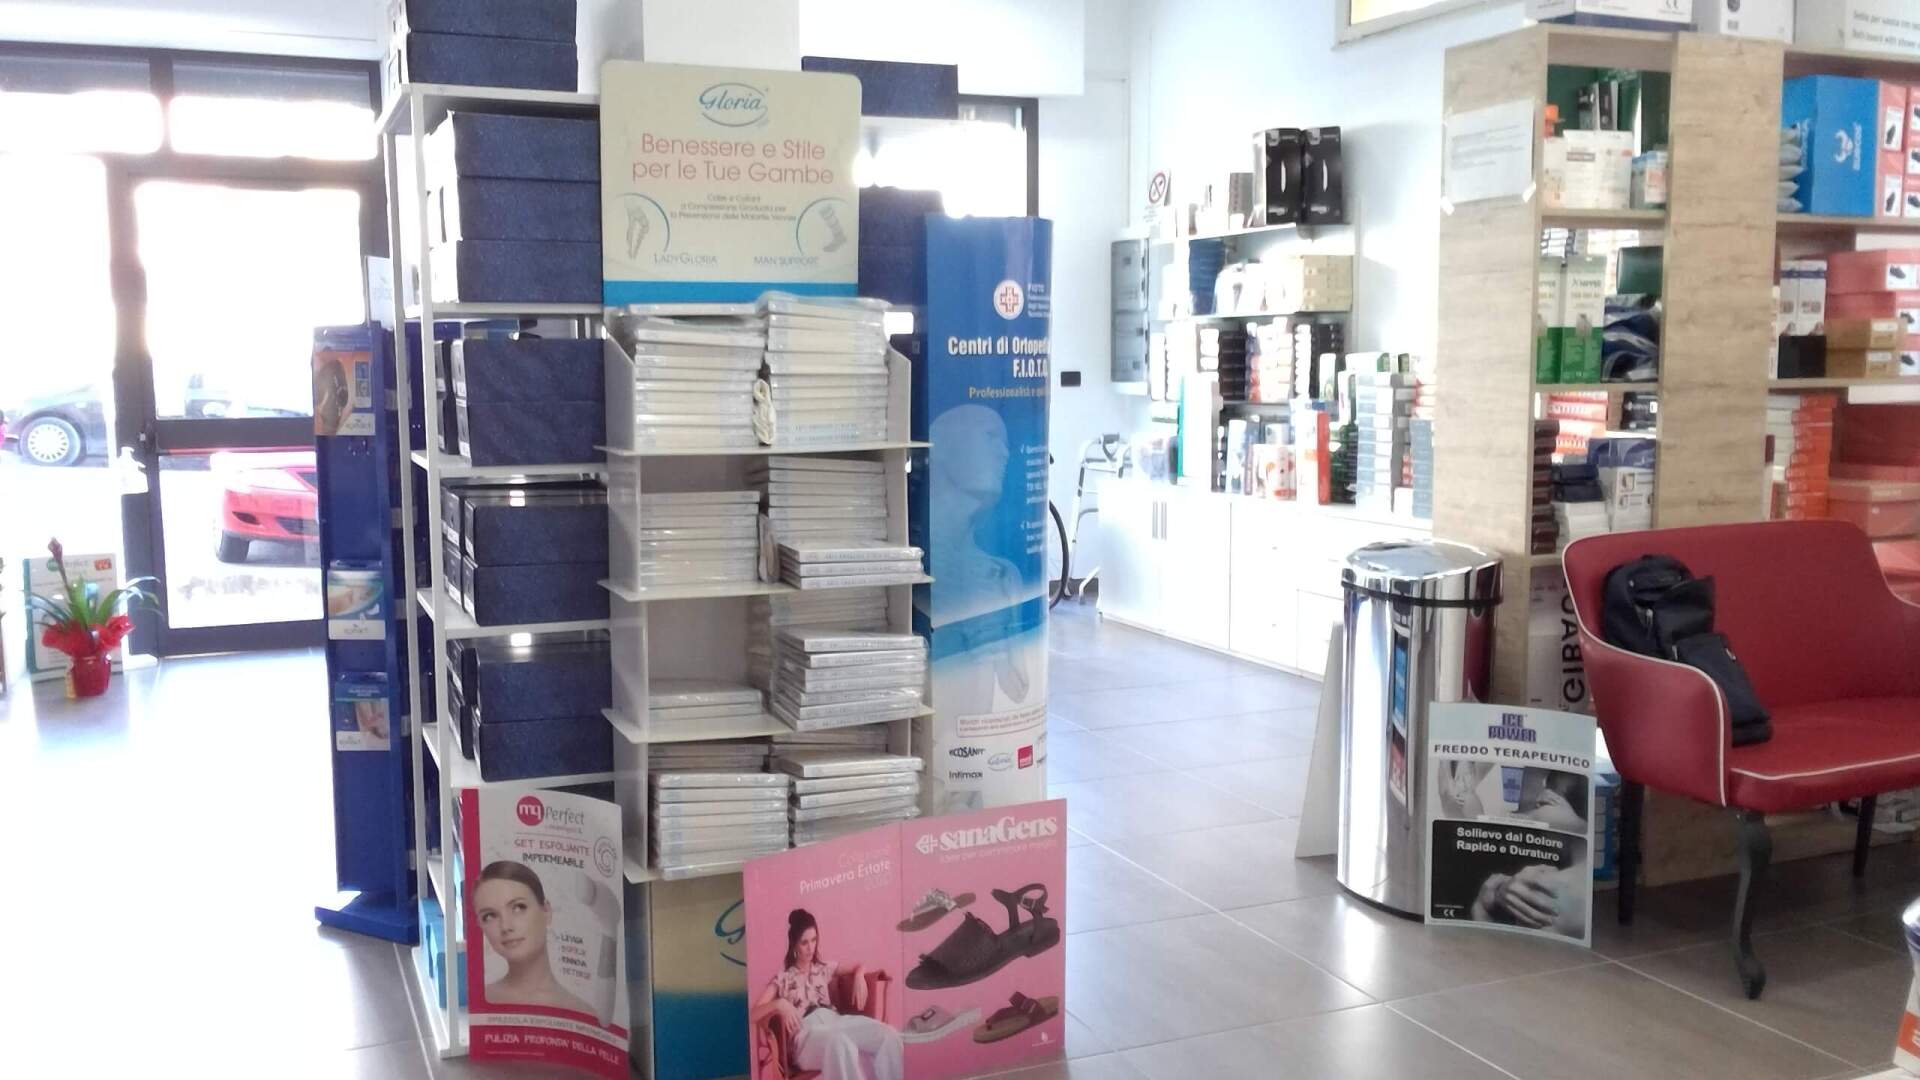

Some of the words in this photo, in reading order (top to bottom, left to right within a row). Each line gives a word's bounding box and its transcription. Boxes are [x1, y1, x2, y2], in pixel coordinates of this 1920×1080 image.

[699, 88, 763, 112] Gloria
[641, 132, 756, 158] Benessere
[762, 143, 777, 159] e
[783, 138, 826, 161] Stile
[631, 161, 672, 183] per
[677, 160, 697, 180] le
[702, 160, 741, 182] Tue
[748, 161, 834, 185] Gambe
[947, 336, 993, 356] Centri
[996, 336, 1009, 355] di
[1502, 713, 1524, 729] ICE
[1488, 725, 1537, 744] POWER
[1434, 743, 1489, 756] FREDDO
[1493, 747, 1591, 769] TERAPEUTICO
[545, 805, 585, 826] Perfect
[939, 815, 1058, 852] sanaGens
[1456, 827, 1503, 841] Sollievo
[1505, 831, 1523, 843] dal
[1526, 834, 1564, 850] Dolore
[514, 838, 534, 850] SET
[539, 840, 591, 856] ESFOLIANTE
[1456, 840, 1497, 854] Rapido
[1499, 845, 1507, 854] e
[1509, 845, 1560, 862] Duraturo
[522, 853, 585, 869] IMPERMEABILE
[800, 867, 855, 896] Primavera
[857, 859, 891, 881] Estate
[571, 1040, 597, 1057] DELLA
